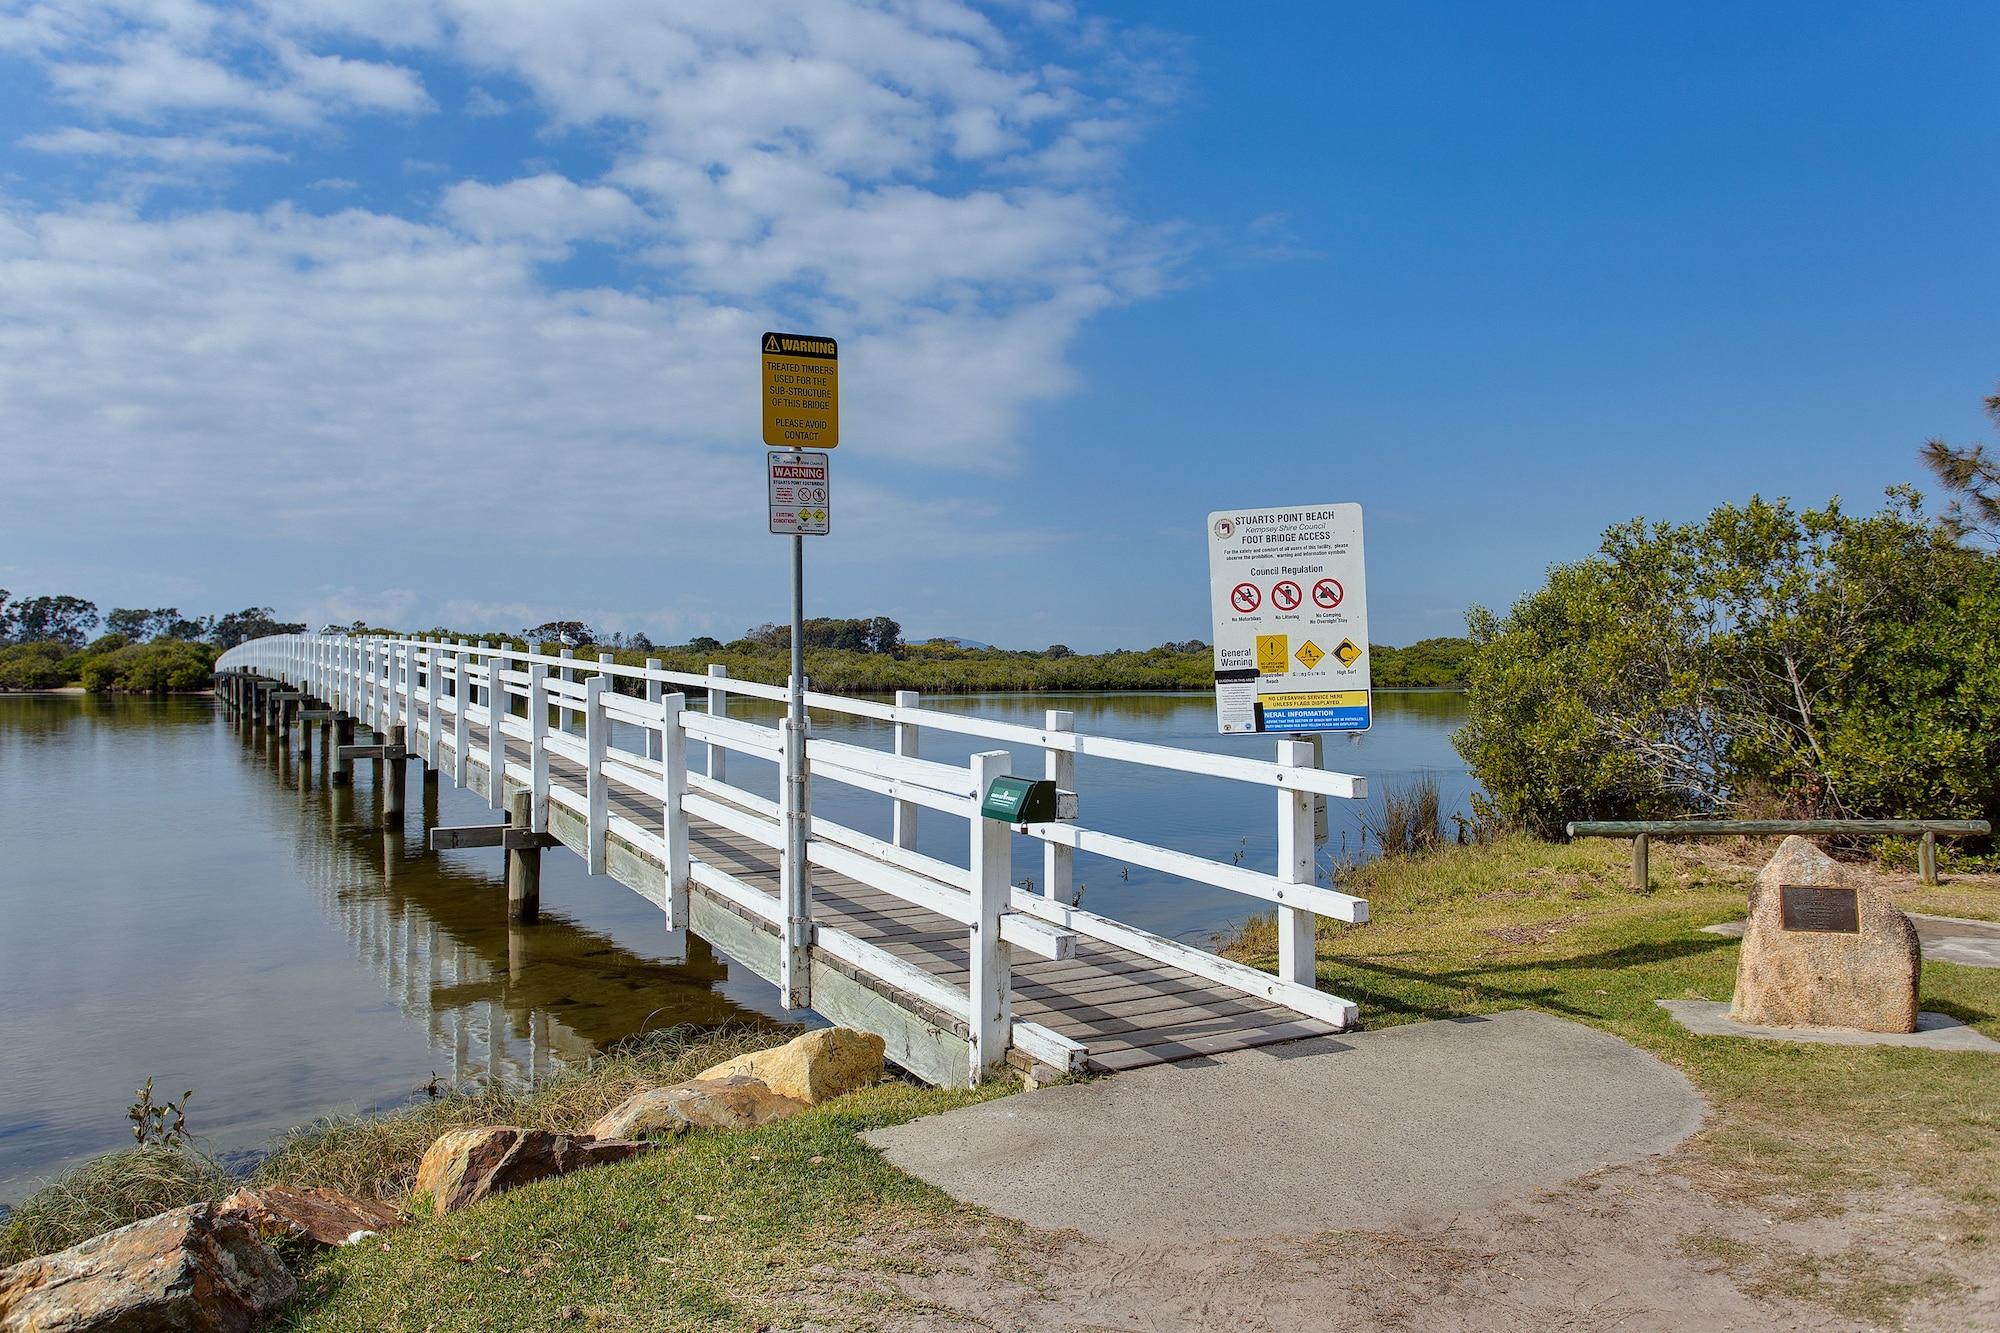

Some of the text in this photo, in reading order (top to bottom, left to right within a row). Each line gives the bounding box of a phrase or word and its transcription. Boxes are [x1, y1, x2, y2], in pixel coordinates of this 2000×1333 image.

[782, 339, 834, 354] WARNING
[767, 362, 834, 375] TREATED TIMBERS
[774, 374, 826, 386] USED FOR THE
[770, 386, 832, 398] SUB-STRUCTURE
[772, 398, 830, 409] OF THIS BRIDGE
[776, 418, 827, 429] PLEASE AVOID
[785, 431, 818, 440] CONTACT
[774, 467, 822, 478] WARNING
[1235, 511, 1334, 525] STUARTS POINT BEACH
[1245, 526, 1278, 534] Kempsey
[1242, 531, 1330, 544] FOOT BRIDGE ACCESS
[1250, 565, 1323, 576] Council Regulation
[1221, 649, 1251, 657] General
[1221, 658, 1253, 667] Warning
